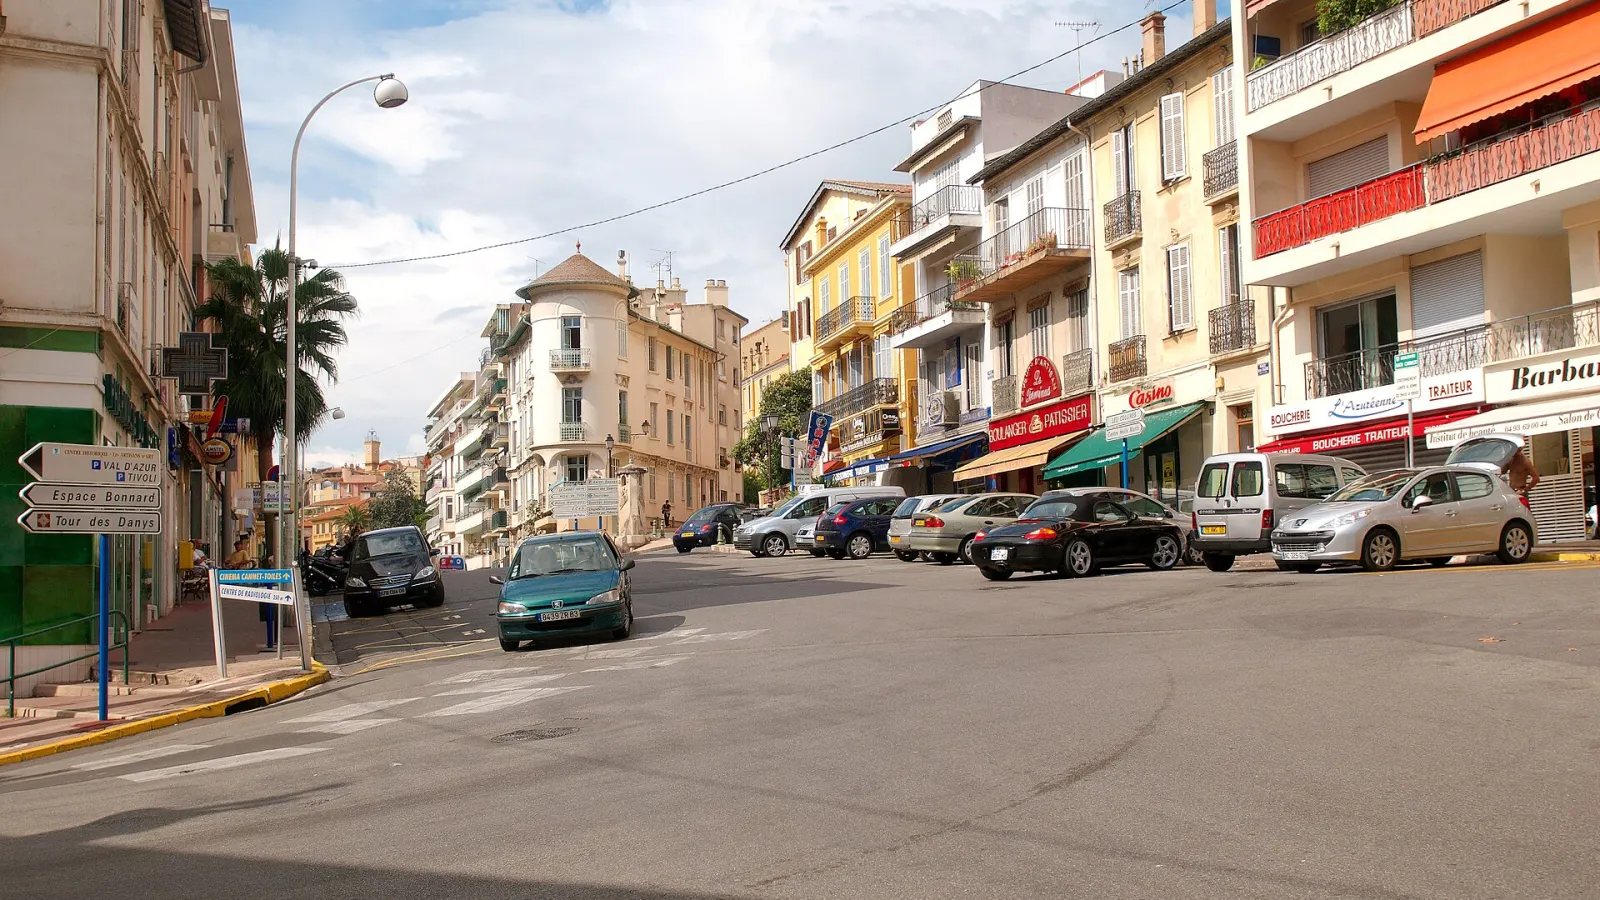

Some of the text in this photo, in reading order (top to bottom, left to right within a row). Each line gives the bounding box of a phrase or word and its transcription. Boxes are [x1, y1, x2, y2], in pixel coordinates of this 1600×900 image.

[1129, 385, 1172, 409] Casino
[1429, 379, 1473, 398] TRAITEUR
[1328, 397, 1398, 417] L'Azuréenne
[989, 403, 1088, 443] BOULANGER PATISSIER
[1271, 409, 1311, 426] BOUCHERIE
[1429, 431, 1457, 444] Institut
[1458, 429, 1467, 440] de
[1469, 425, 1496, 438] beauté
[1558, 412, 1582, 425] Salon
[1584, 410, 1595, 421] de
[1313, 434, 1361, 450] BOUCHERIE
[1364, 426, 1410, 443] TRAITEUR
[104, 461, 120, 471] VAL
[124, 462, 157, 473] D'AZUR
[128, 473, 157, 483] TIVOLI
[53, 490, 155, 503] Espace Bonnard
[56, 516, 155, 530] Tour des Danys
[221, 587, 237, 596] CENTRE
[237, 589, 244, 597] DE
[244, 590, 272, 599] RADIOLOGIE
